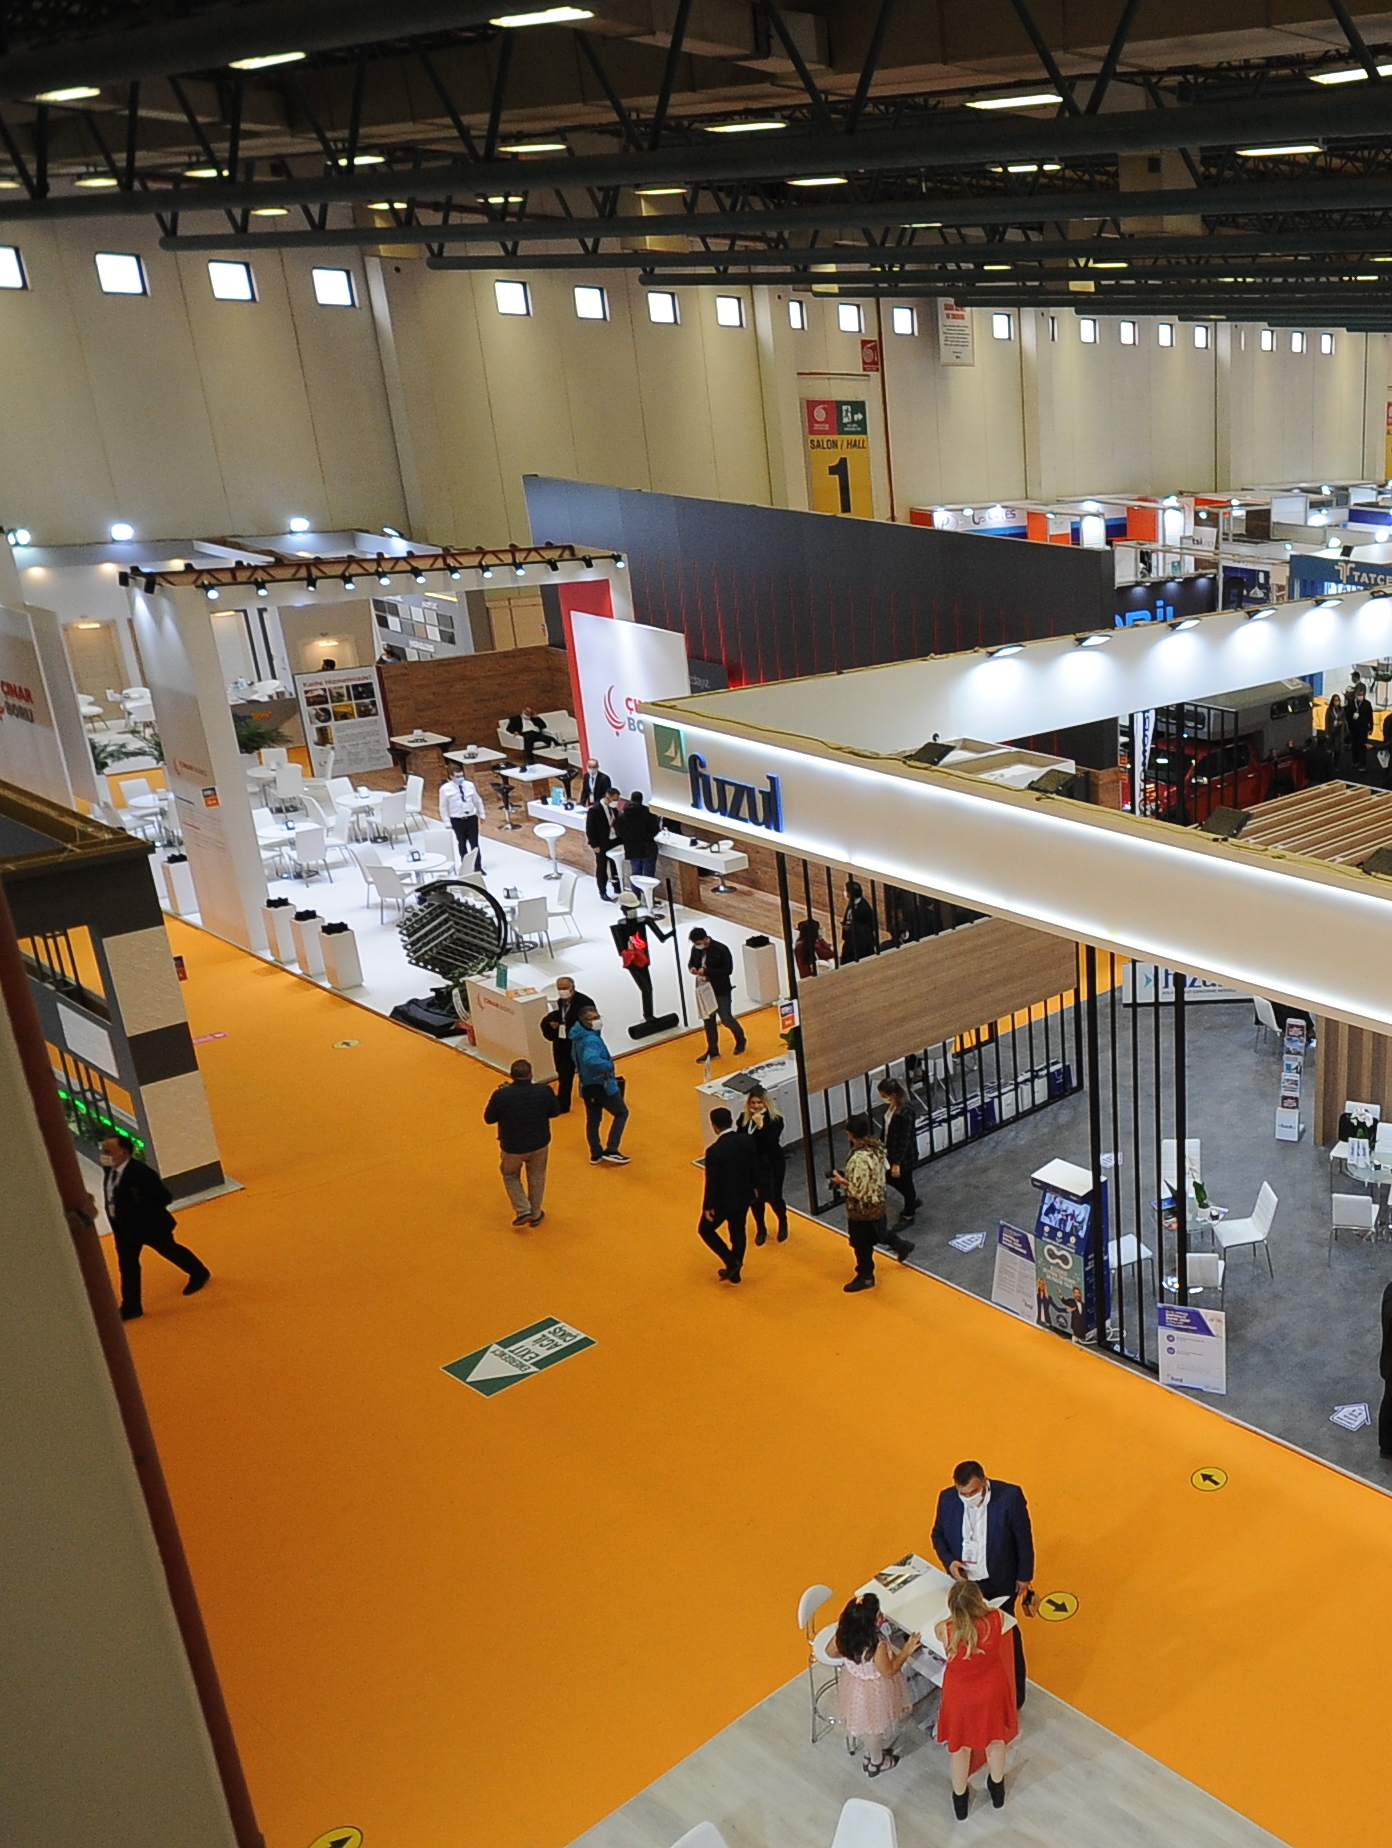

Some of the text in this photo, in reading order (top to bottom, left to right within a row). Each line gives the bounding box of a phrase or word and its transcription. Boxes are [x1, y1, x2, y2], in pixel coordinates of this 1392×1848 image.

[809, 439, 839, 450] SALON
[846, 439, 866, 449] HALL
[827, 457, 852, 515] 1
[688, 753, 784, 833] fuzul
[532, 1334, 562, 1350] ACİL
[510, 1345, 541, 1361] EXIT
